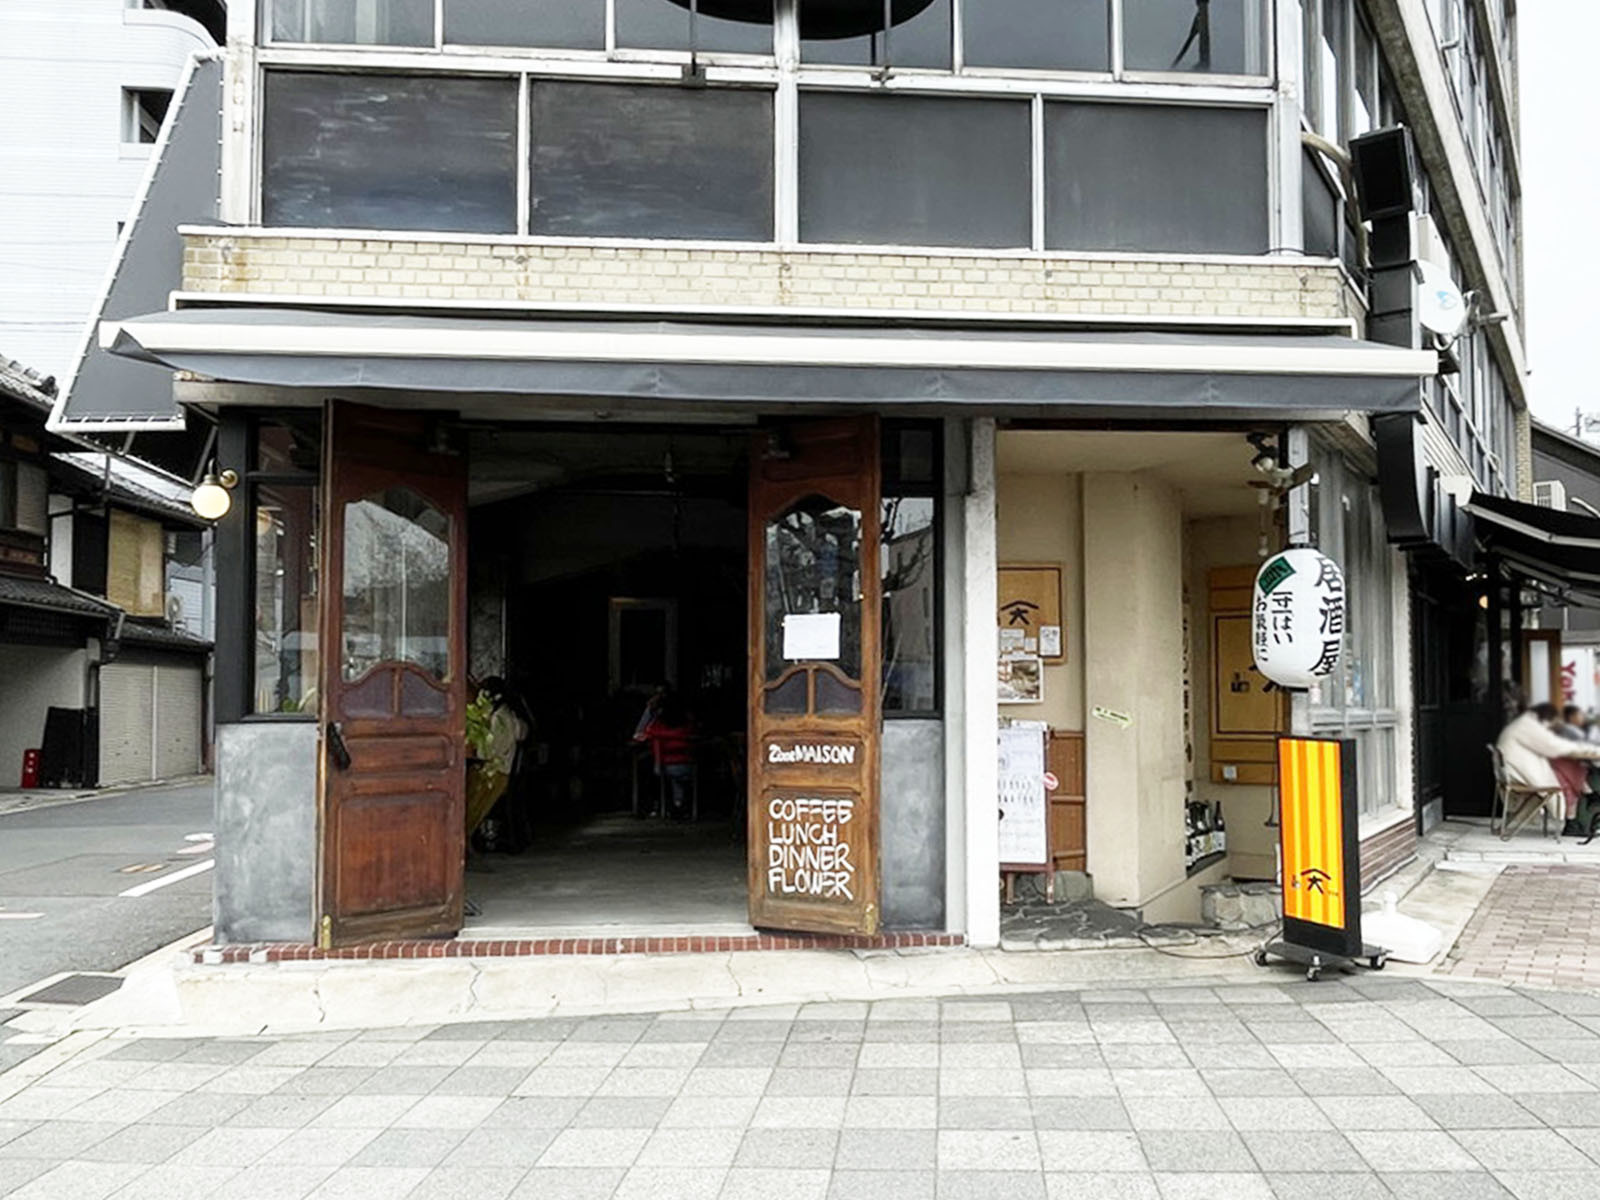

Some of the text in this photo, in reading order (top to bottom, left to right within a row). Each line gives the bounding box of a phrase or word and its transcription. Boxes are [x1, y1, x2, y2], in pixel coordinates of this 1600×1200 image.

[768, 798, 854, 824] COFFEE
[768, 821, 837, 846] LUNCH
[768, 843, 855, 872] DINNER
[768, 867, 854, 900] FLOWER
